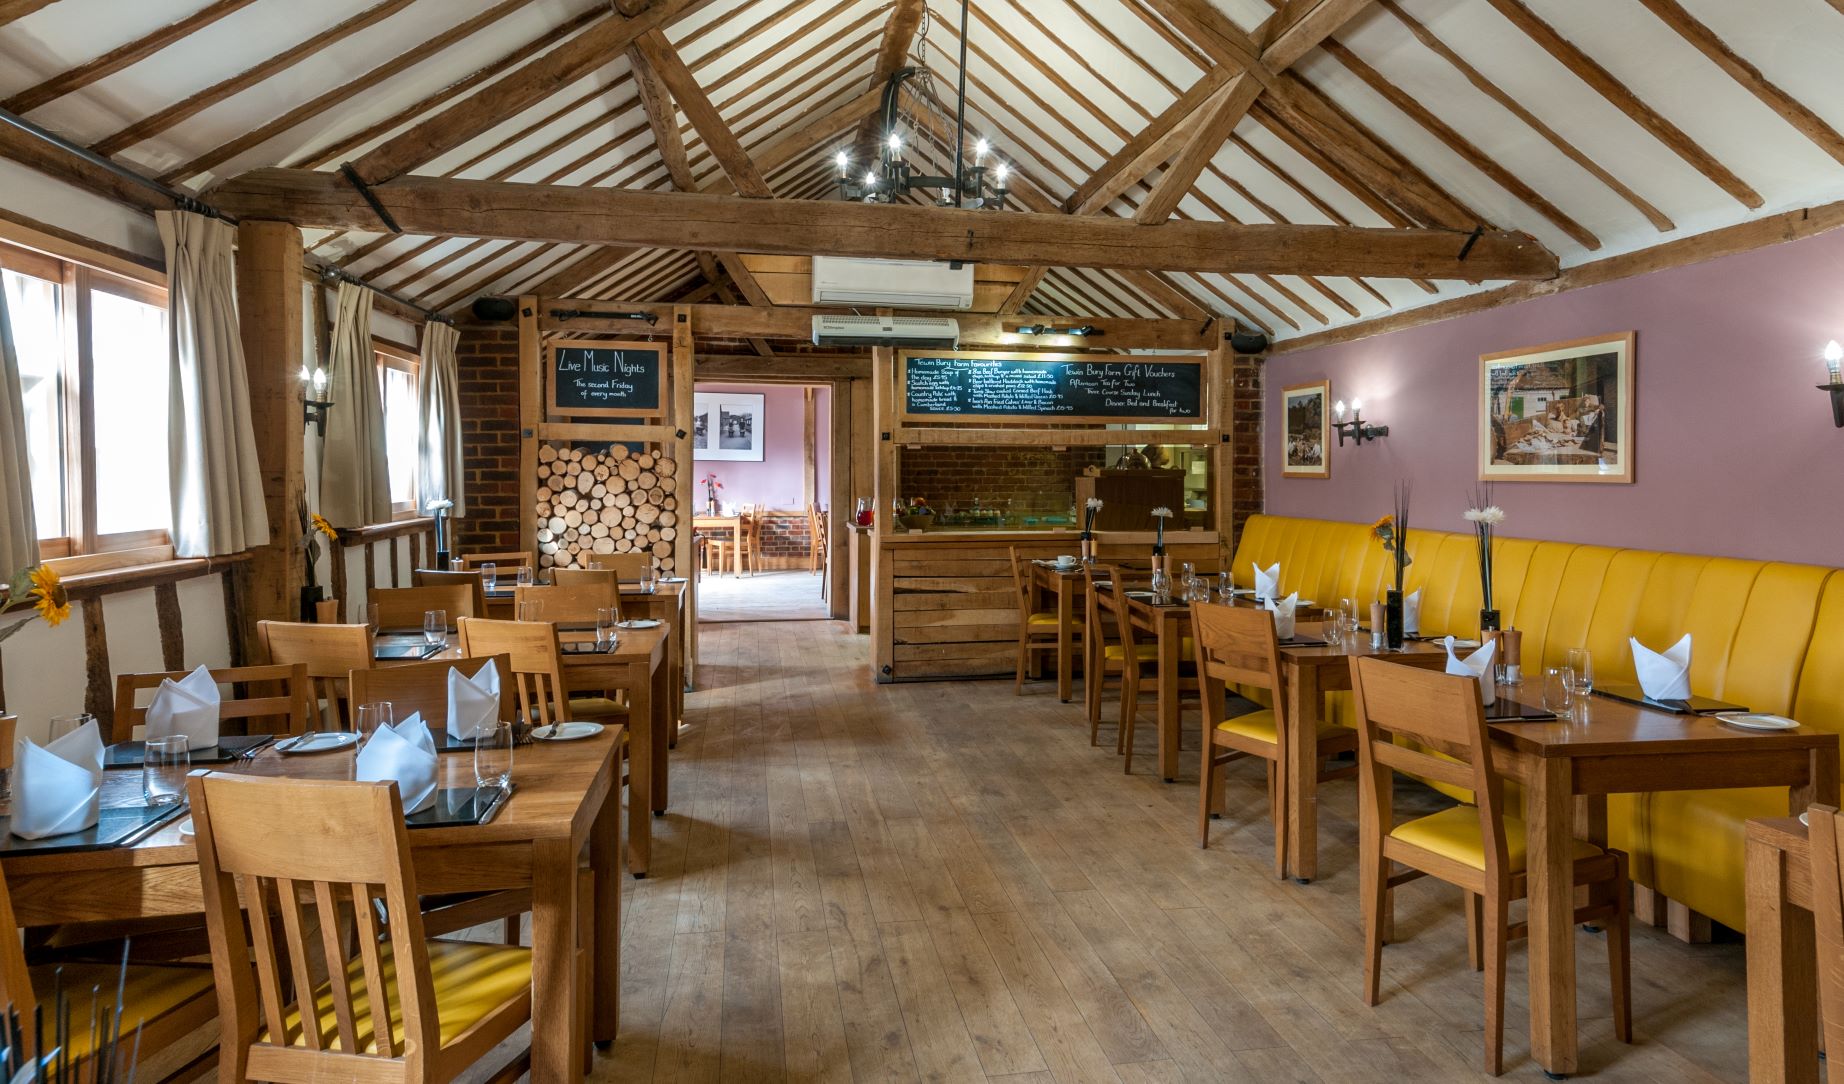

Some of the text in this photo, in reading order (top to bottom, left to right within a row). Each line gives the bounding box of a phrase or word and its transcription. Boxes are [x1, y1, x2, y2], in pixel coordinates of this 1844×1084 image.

[558, 349, 645, 377] Live Music Nights
[936, 359, 951, 368] Bury
[1086, 363, 1104, 378] Bury
[1104, 363, 1121, 376] Farm
[1123, 363, 1141, 379] Gift
[1144, 364, 1176, 378] Vouchers
[573, 377, 634, 392] The second Friday
[1069, 379, 1099, 388] Afternoon
[1110, 379, 1121, 388] for
[1122, 379, 1136, 387] Two
[580, 389, 627, 400] of every month
[1101, 388, 1119, 396] Course
[1120, 388, 1141, 399] Sunday
[1142, 388, 1161, 397] Lunch
[1152, 399, 1178, 411] Breakfast
